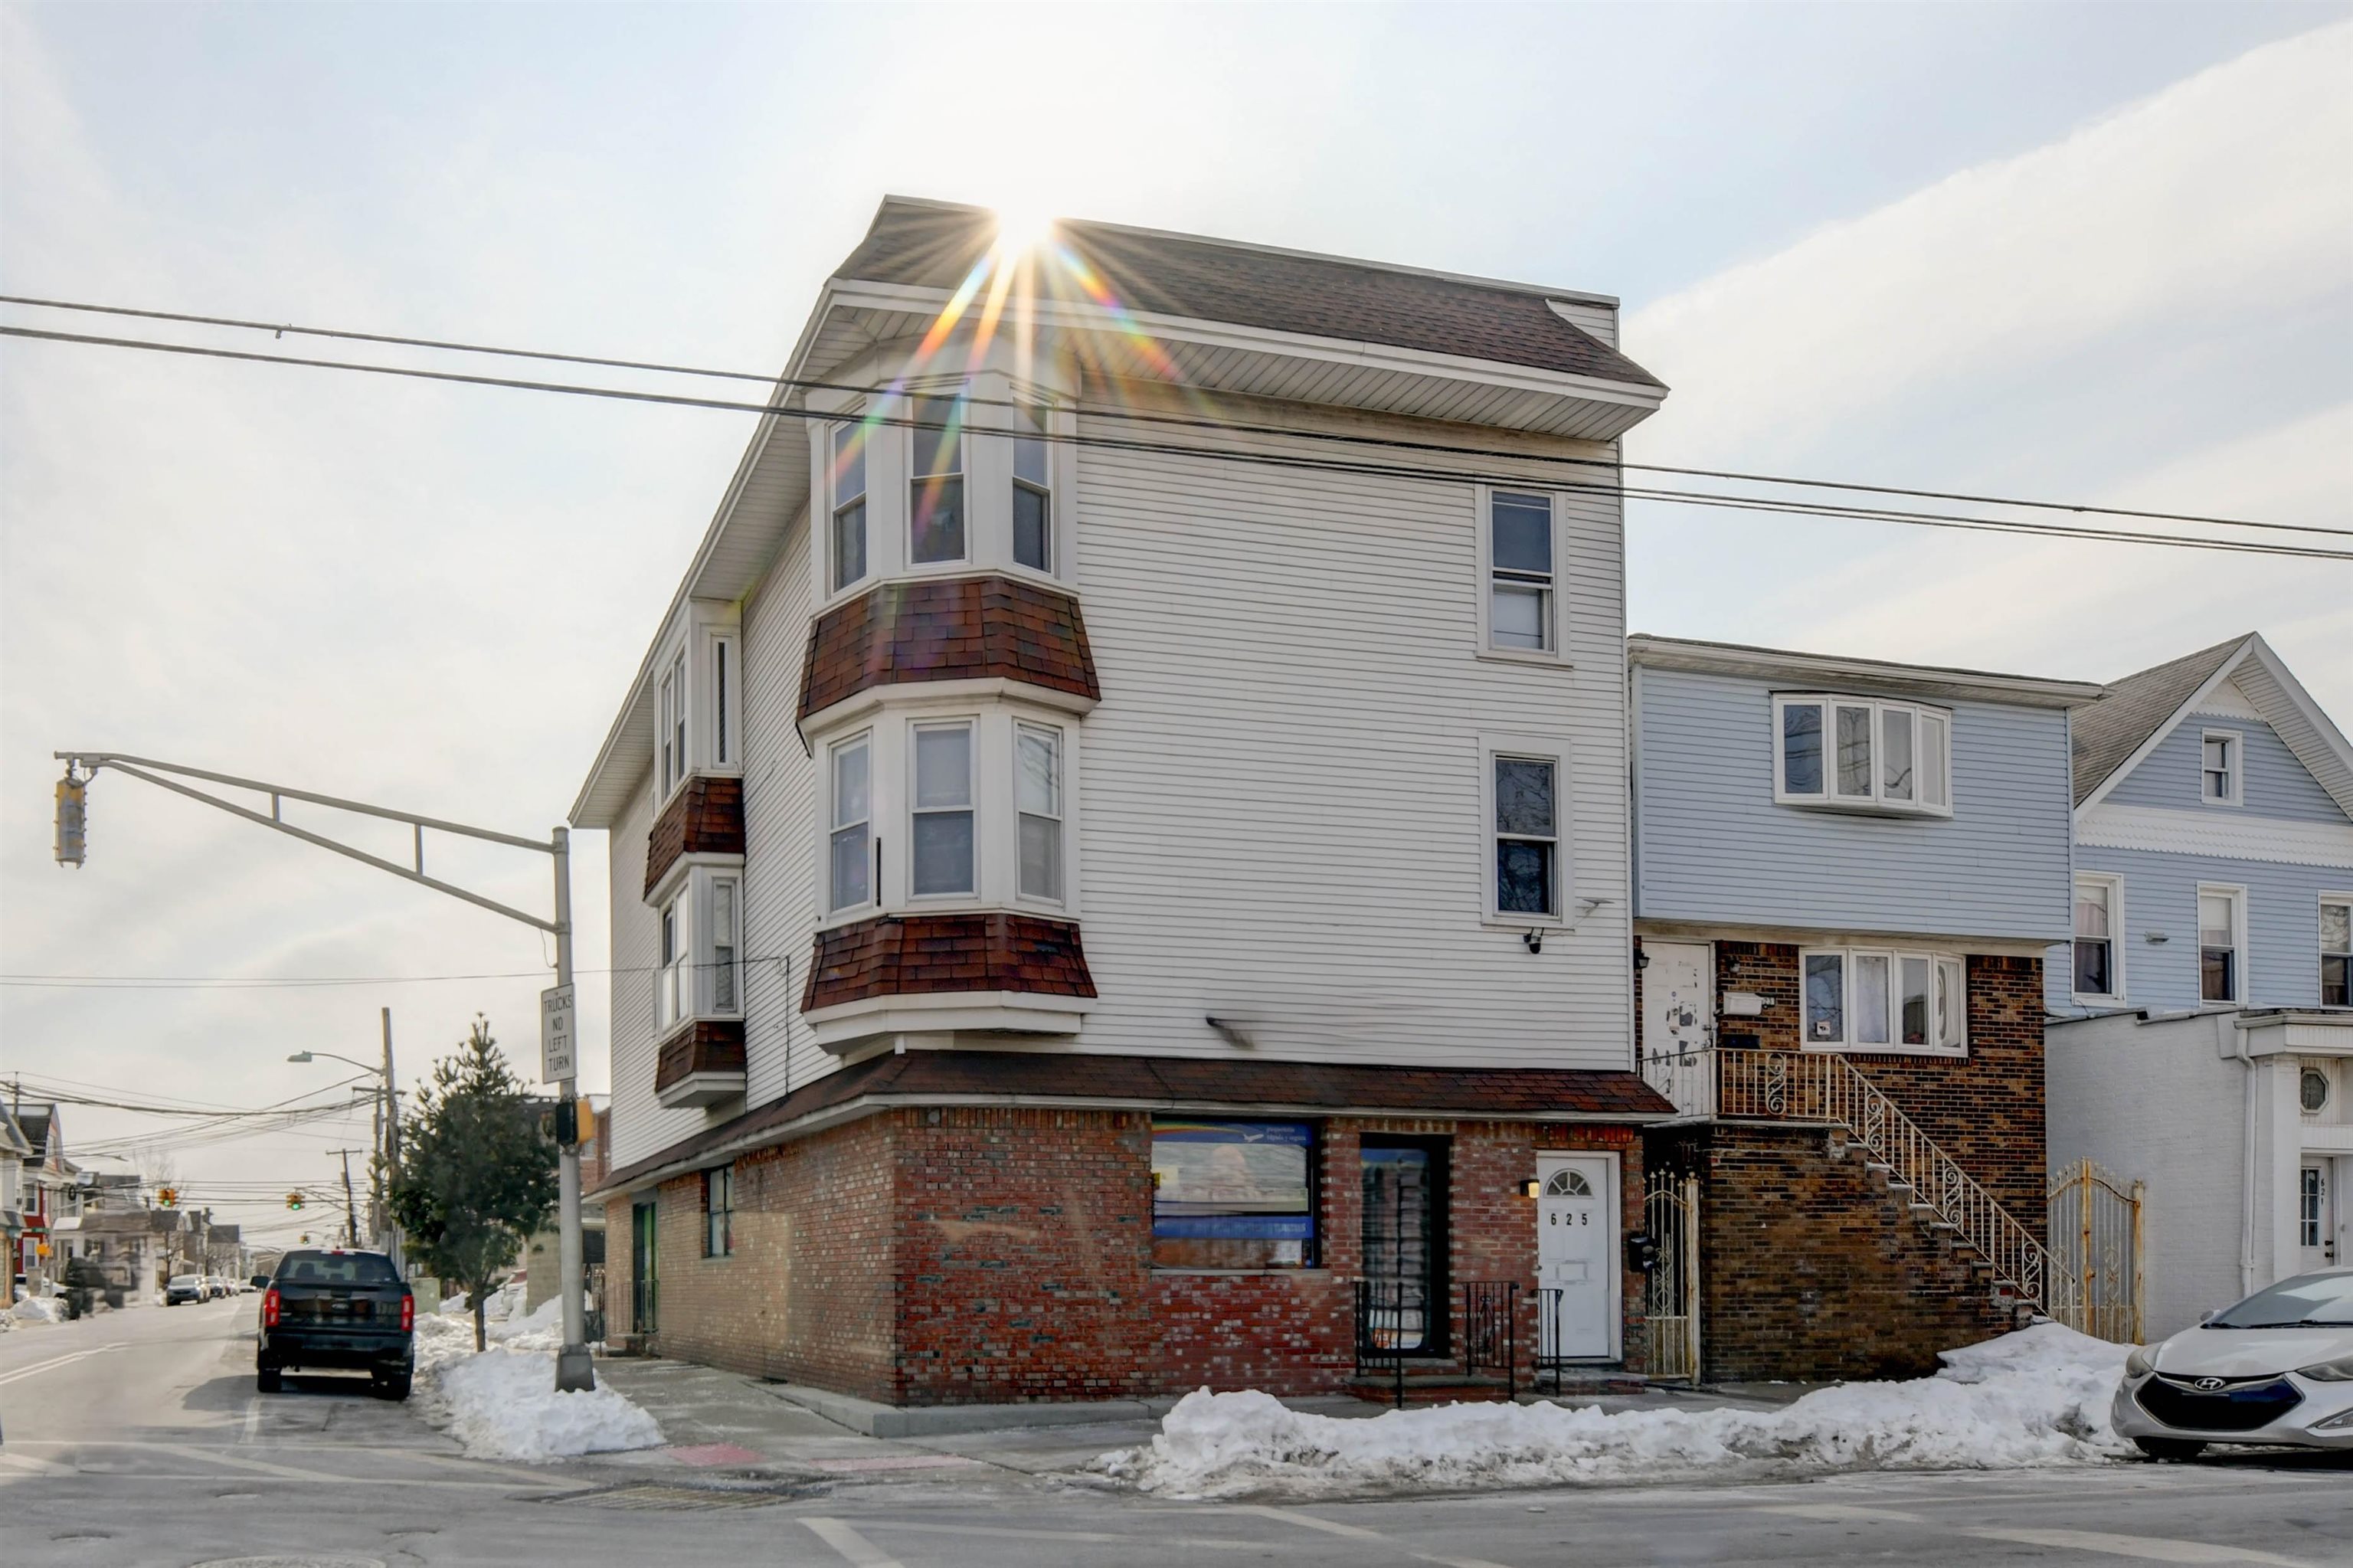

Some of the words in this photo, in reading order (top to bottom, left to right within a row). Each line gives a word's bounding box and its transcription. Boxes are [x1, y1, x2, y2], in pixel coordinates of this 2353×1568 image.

[544, 994, 572, 1015] TRUCKS
[552, 1016, 564, 1033] NO
[548, 1034, 568, 1052] LEFT
[548, 1054, 570, 1072] TURN
[1550, 1213, 1588, 1226] 625
